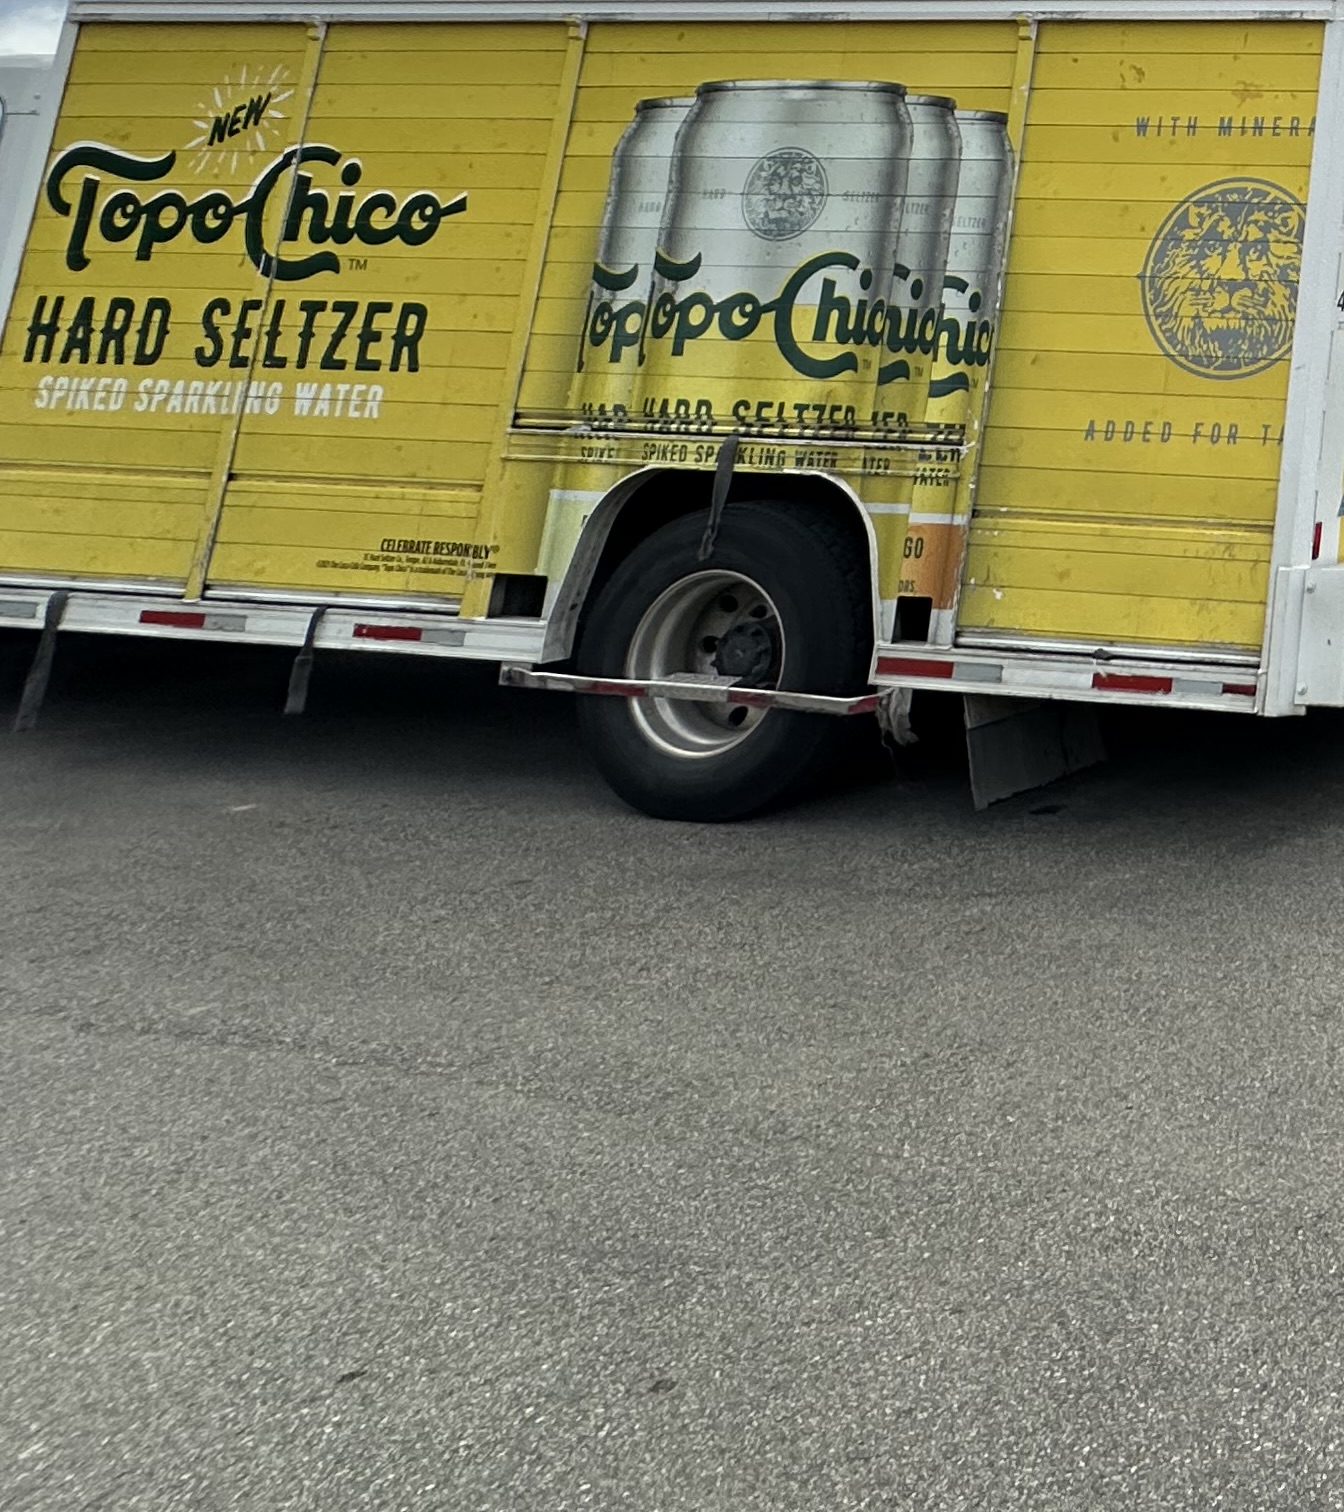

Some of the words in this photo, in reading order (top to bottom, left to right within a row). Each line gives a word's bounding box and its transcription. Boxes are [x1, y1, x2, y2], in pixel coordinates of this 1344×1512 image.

[207, 92, 271, 146] NEW
[1136, 116, 1198, 137] WITH
[23, 295, 172, 366] HARD
[194, 297, 429, 372] SELTZER
[34, 375, 128, 412] SPIKED
[134, 377, 283, 415] SPARKLING
[293, 382, 384, 419] WATER
[1084, 419, 1173, 444] ADDED
[1192, 422, 1239, 446] FOR
[641, 442, 688, 463] SPIKED
[380, 538, 433, 554] CELEBRATE
